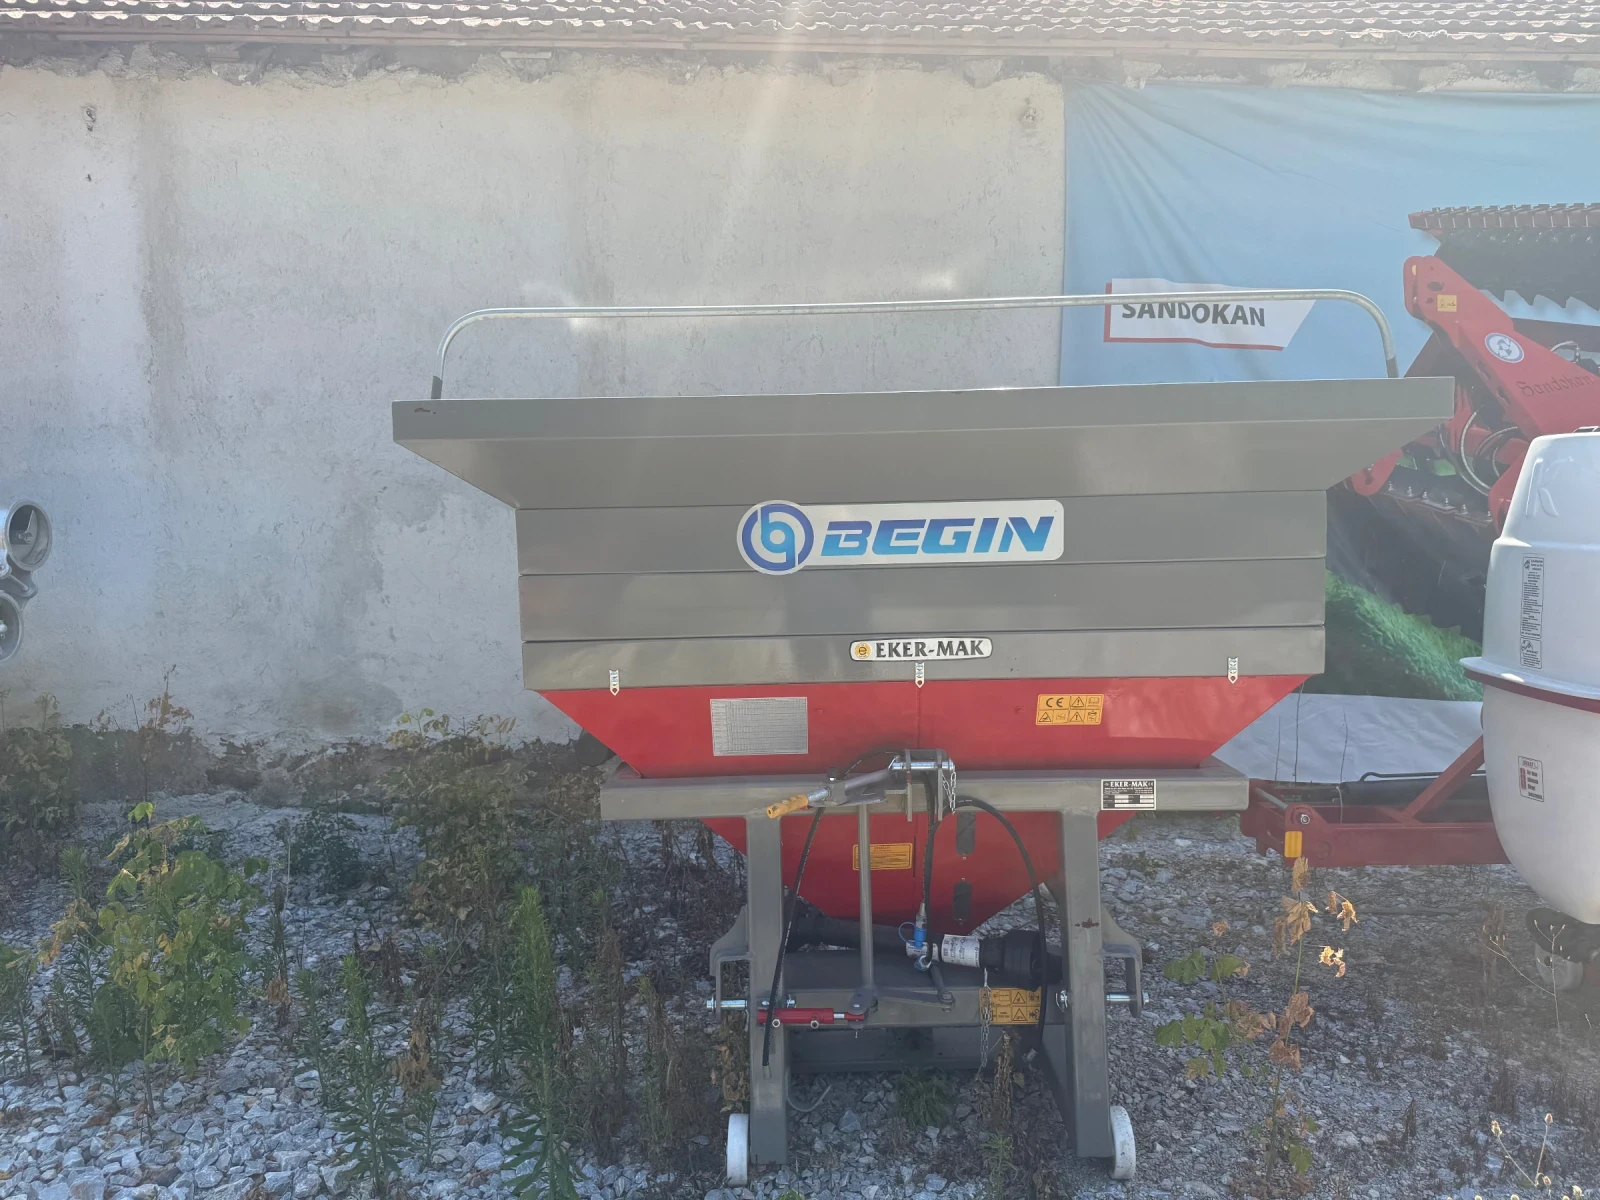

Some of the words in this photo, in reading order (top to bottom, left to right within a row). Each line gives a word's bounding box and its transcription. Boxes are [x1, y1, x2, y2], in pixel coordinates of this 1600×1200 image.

[1122, 302, 1265, 327] SANDOKAN
[1516, 374, 1596, 397] Sandokan
[820, 516, 1055, 557] BEGIN
[875, 640, 984, 658] EKER-MAK
